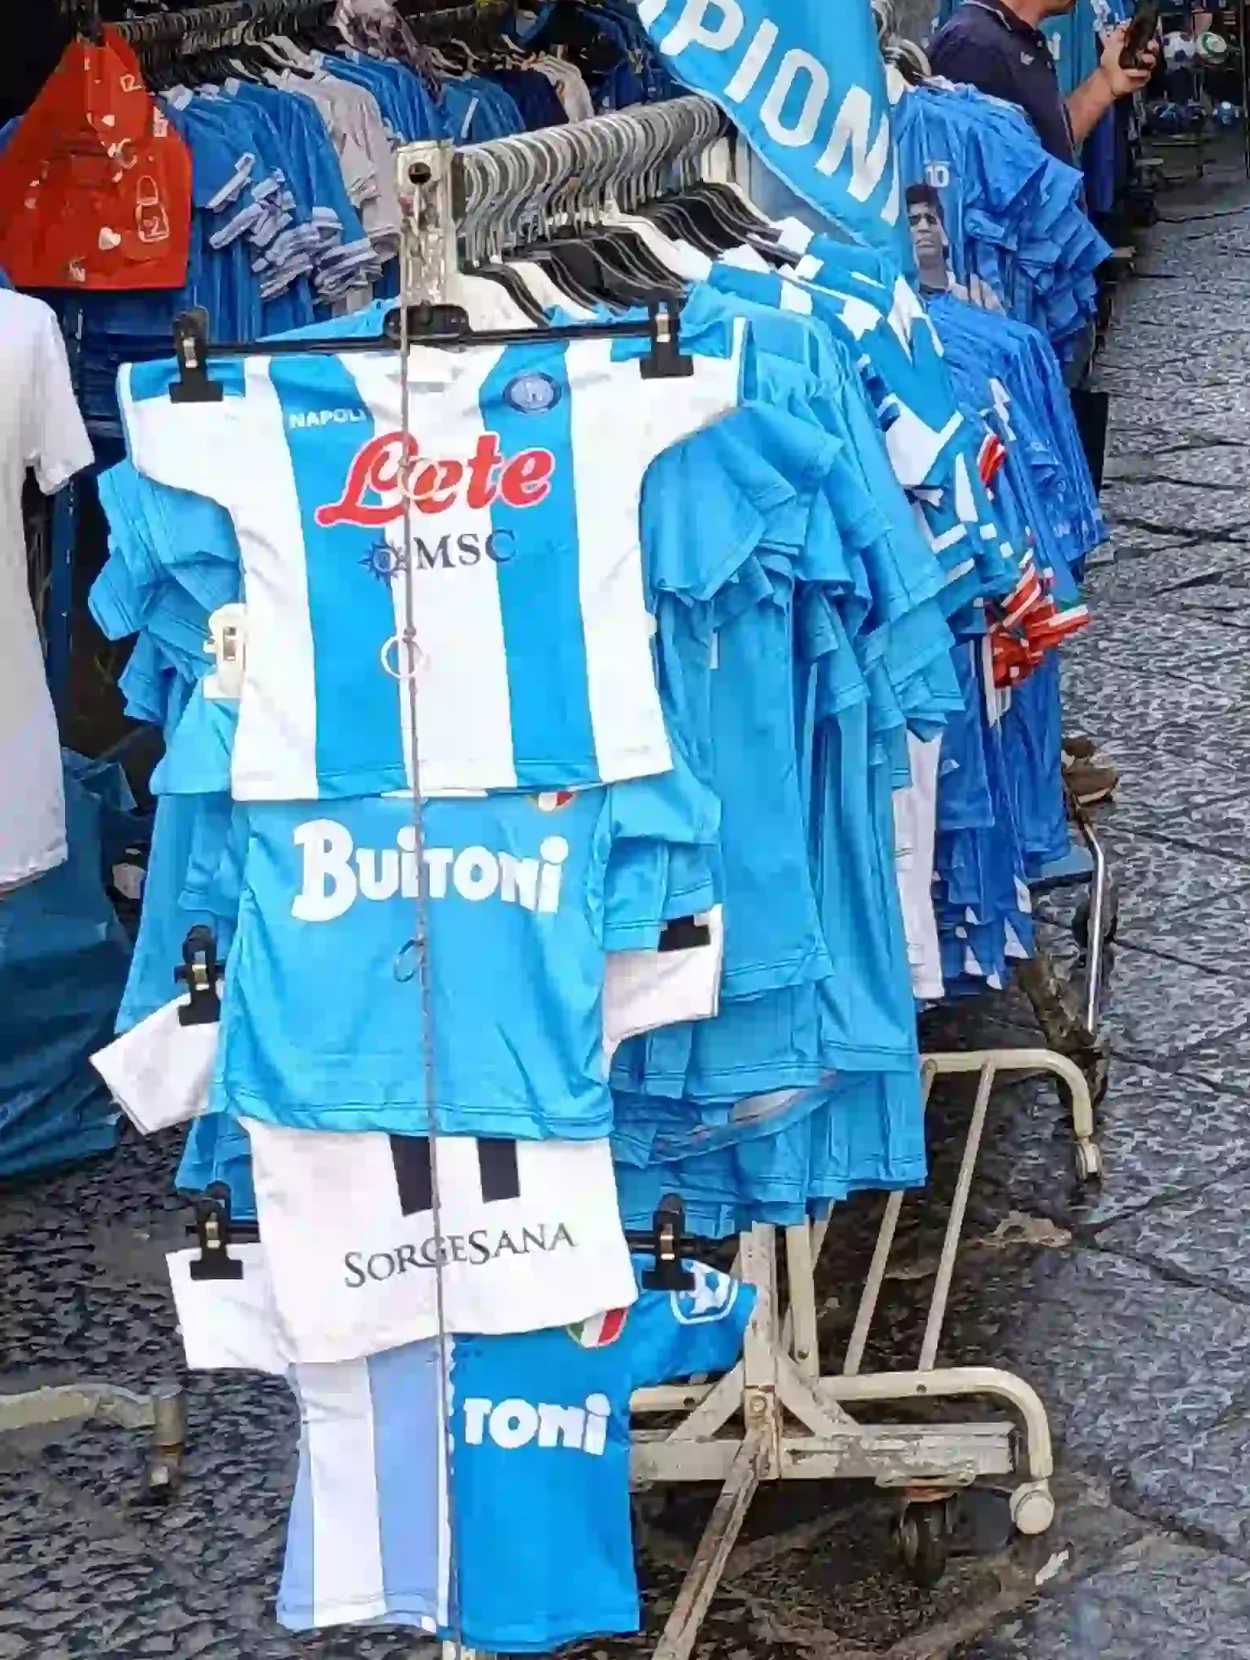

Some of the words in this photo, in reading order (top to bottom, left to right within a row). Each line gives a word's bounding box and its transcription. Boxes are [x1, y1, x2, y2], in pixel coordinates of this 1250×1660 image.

[924, 165, 950, 188] 10
[289, 408, 367, 429] NAPOLI
[314, 429, 557, 529] Lete
[412, 529, 517, 572] MSC
